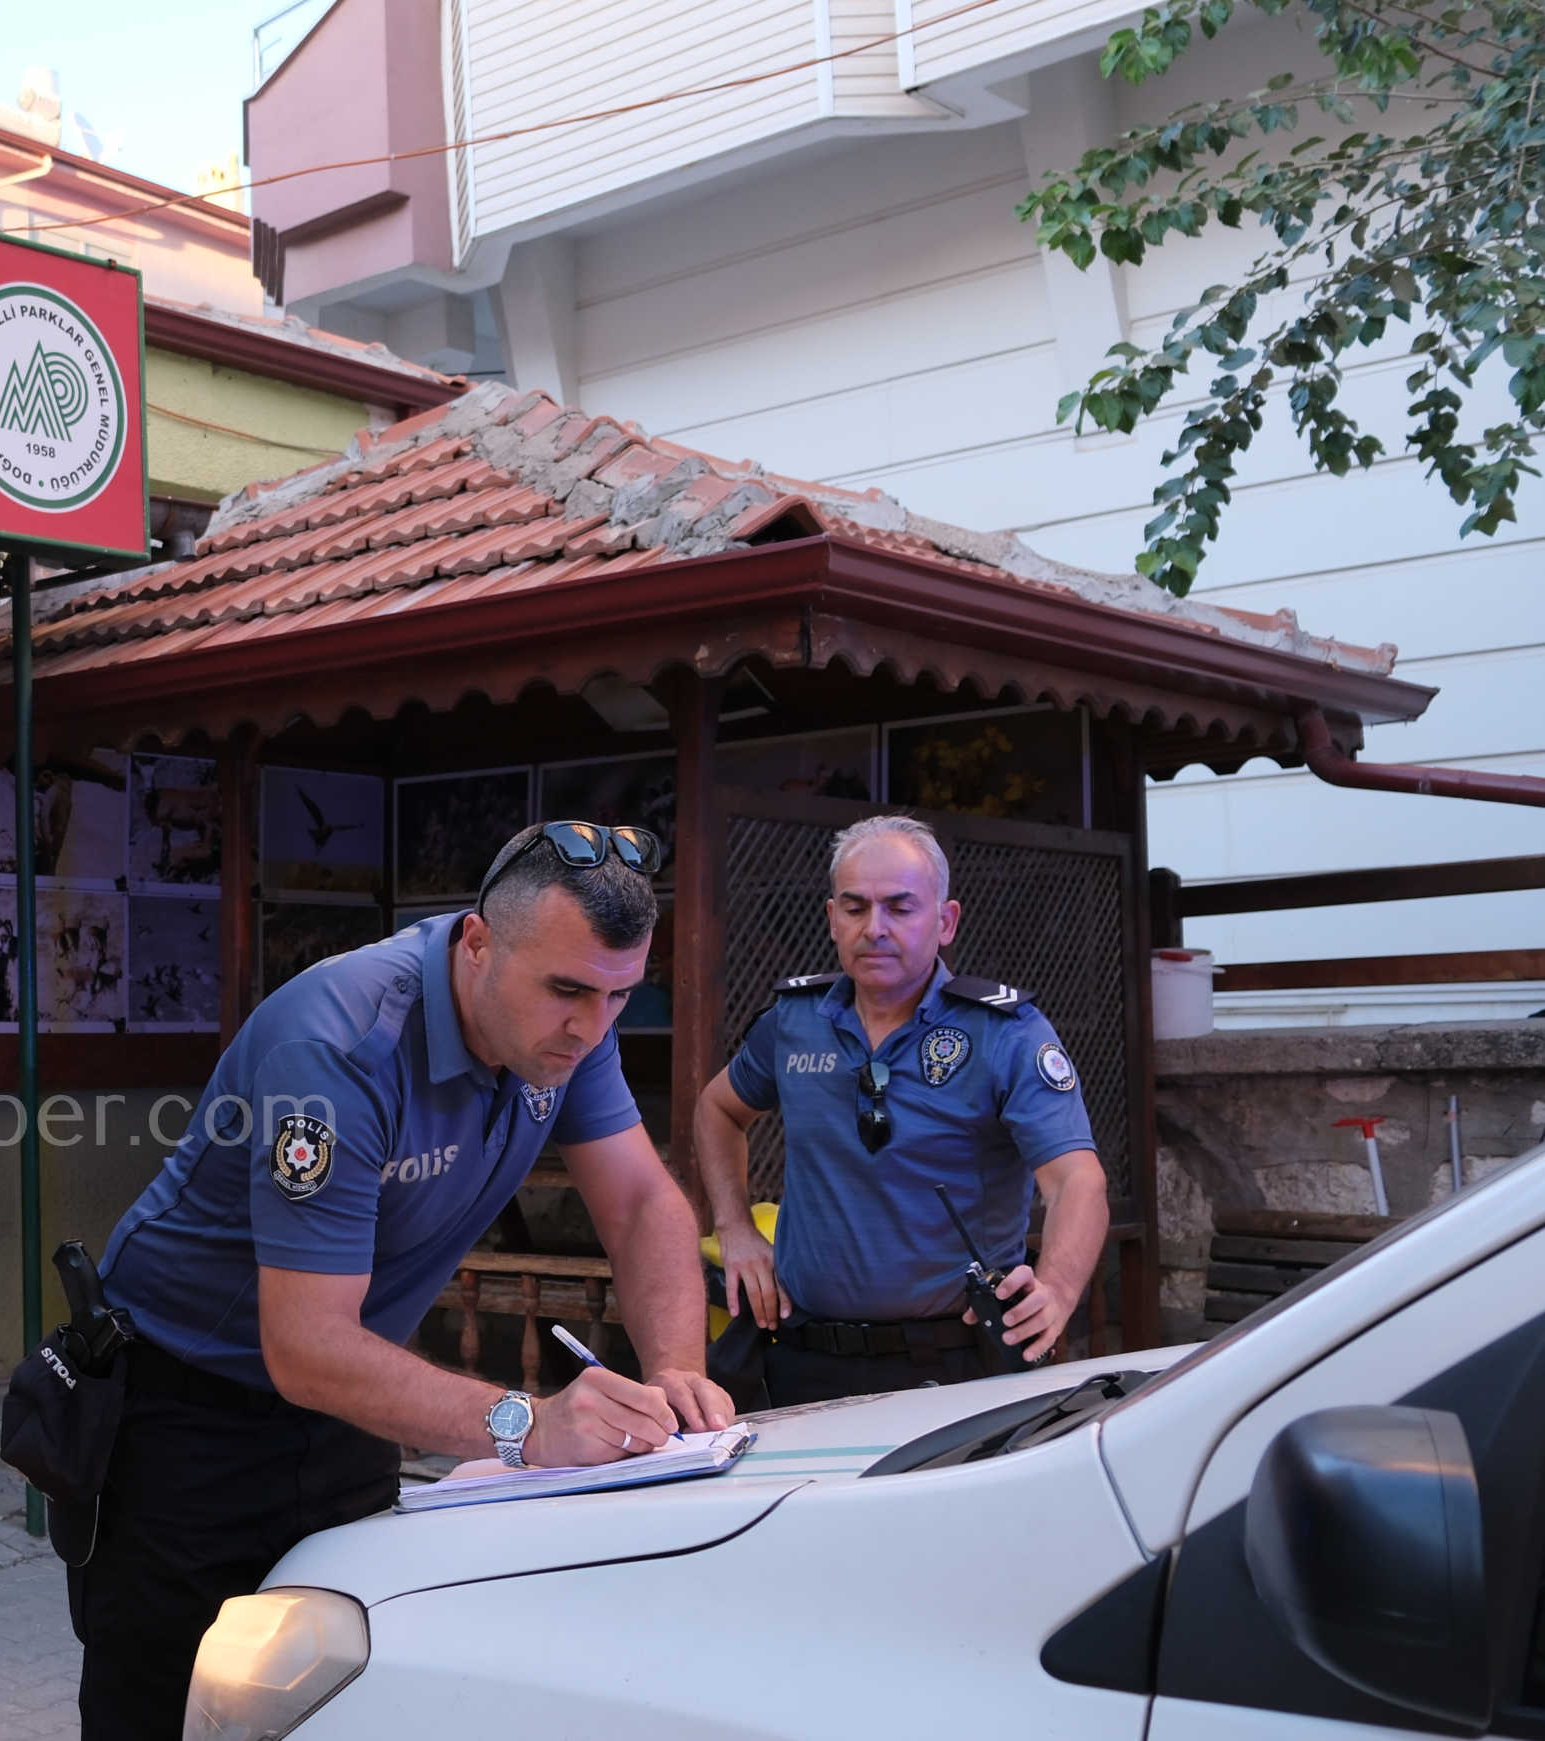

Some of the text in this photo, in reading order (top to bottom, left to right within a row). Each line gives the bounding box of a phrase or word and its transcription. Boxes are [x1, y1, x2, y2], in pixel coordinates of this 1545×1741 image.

[21, 304, 84, 347] PARKLAR
[84, 349, 109, 407] GENEL
[25, 443, 56, 458] 1958
[50, 414, 110, 490] MÜDÜRLÜĞÜ
[786, 1053, 838, 1074] POLİS
[286, 1118, 329, 1141] POLİS
